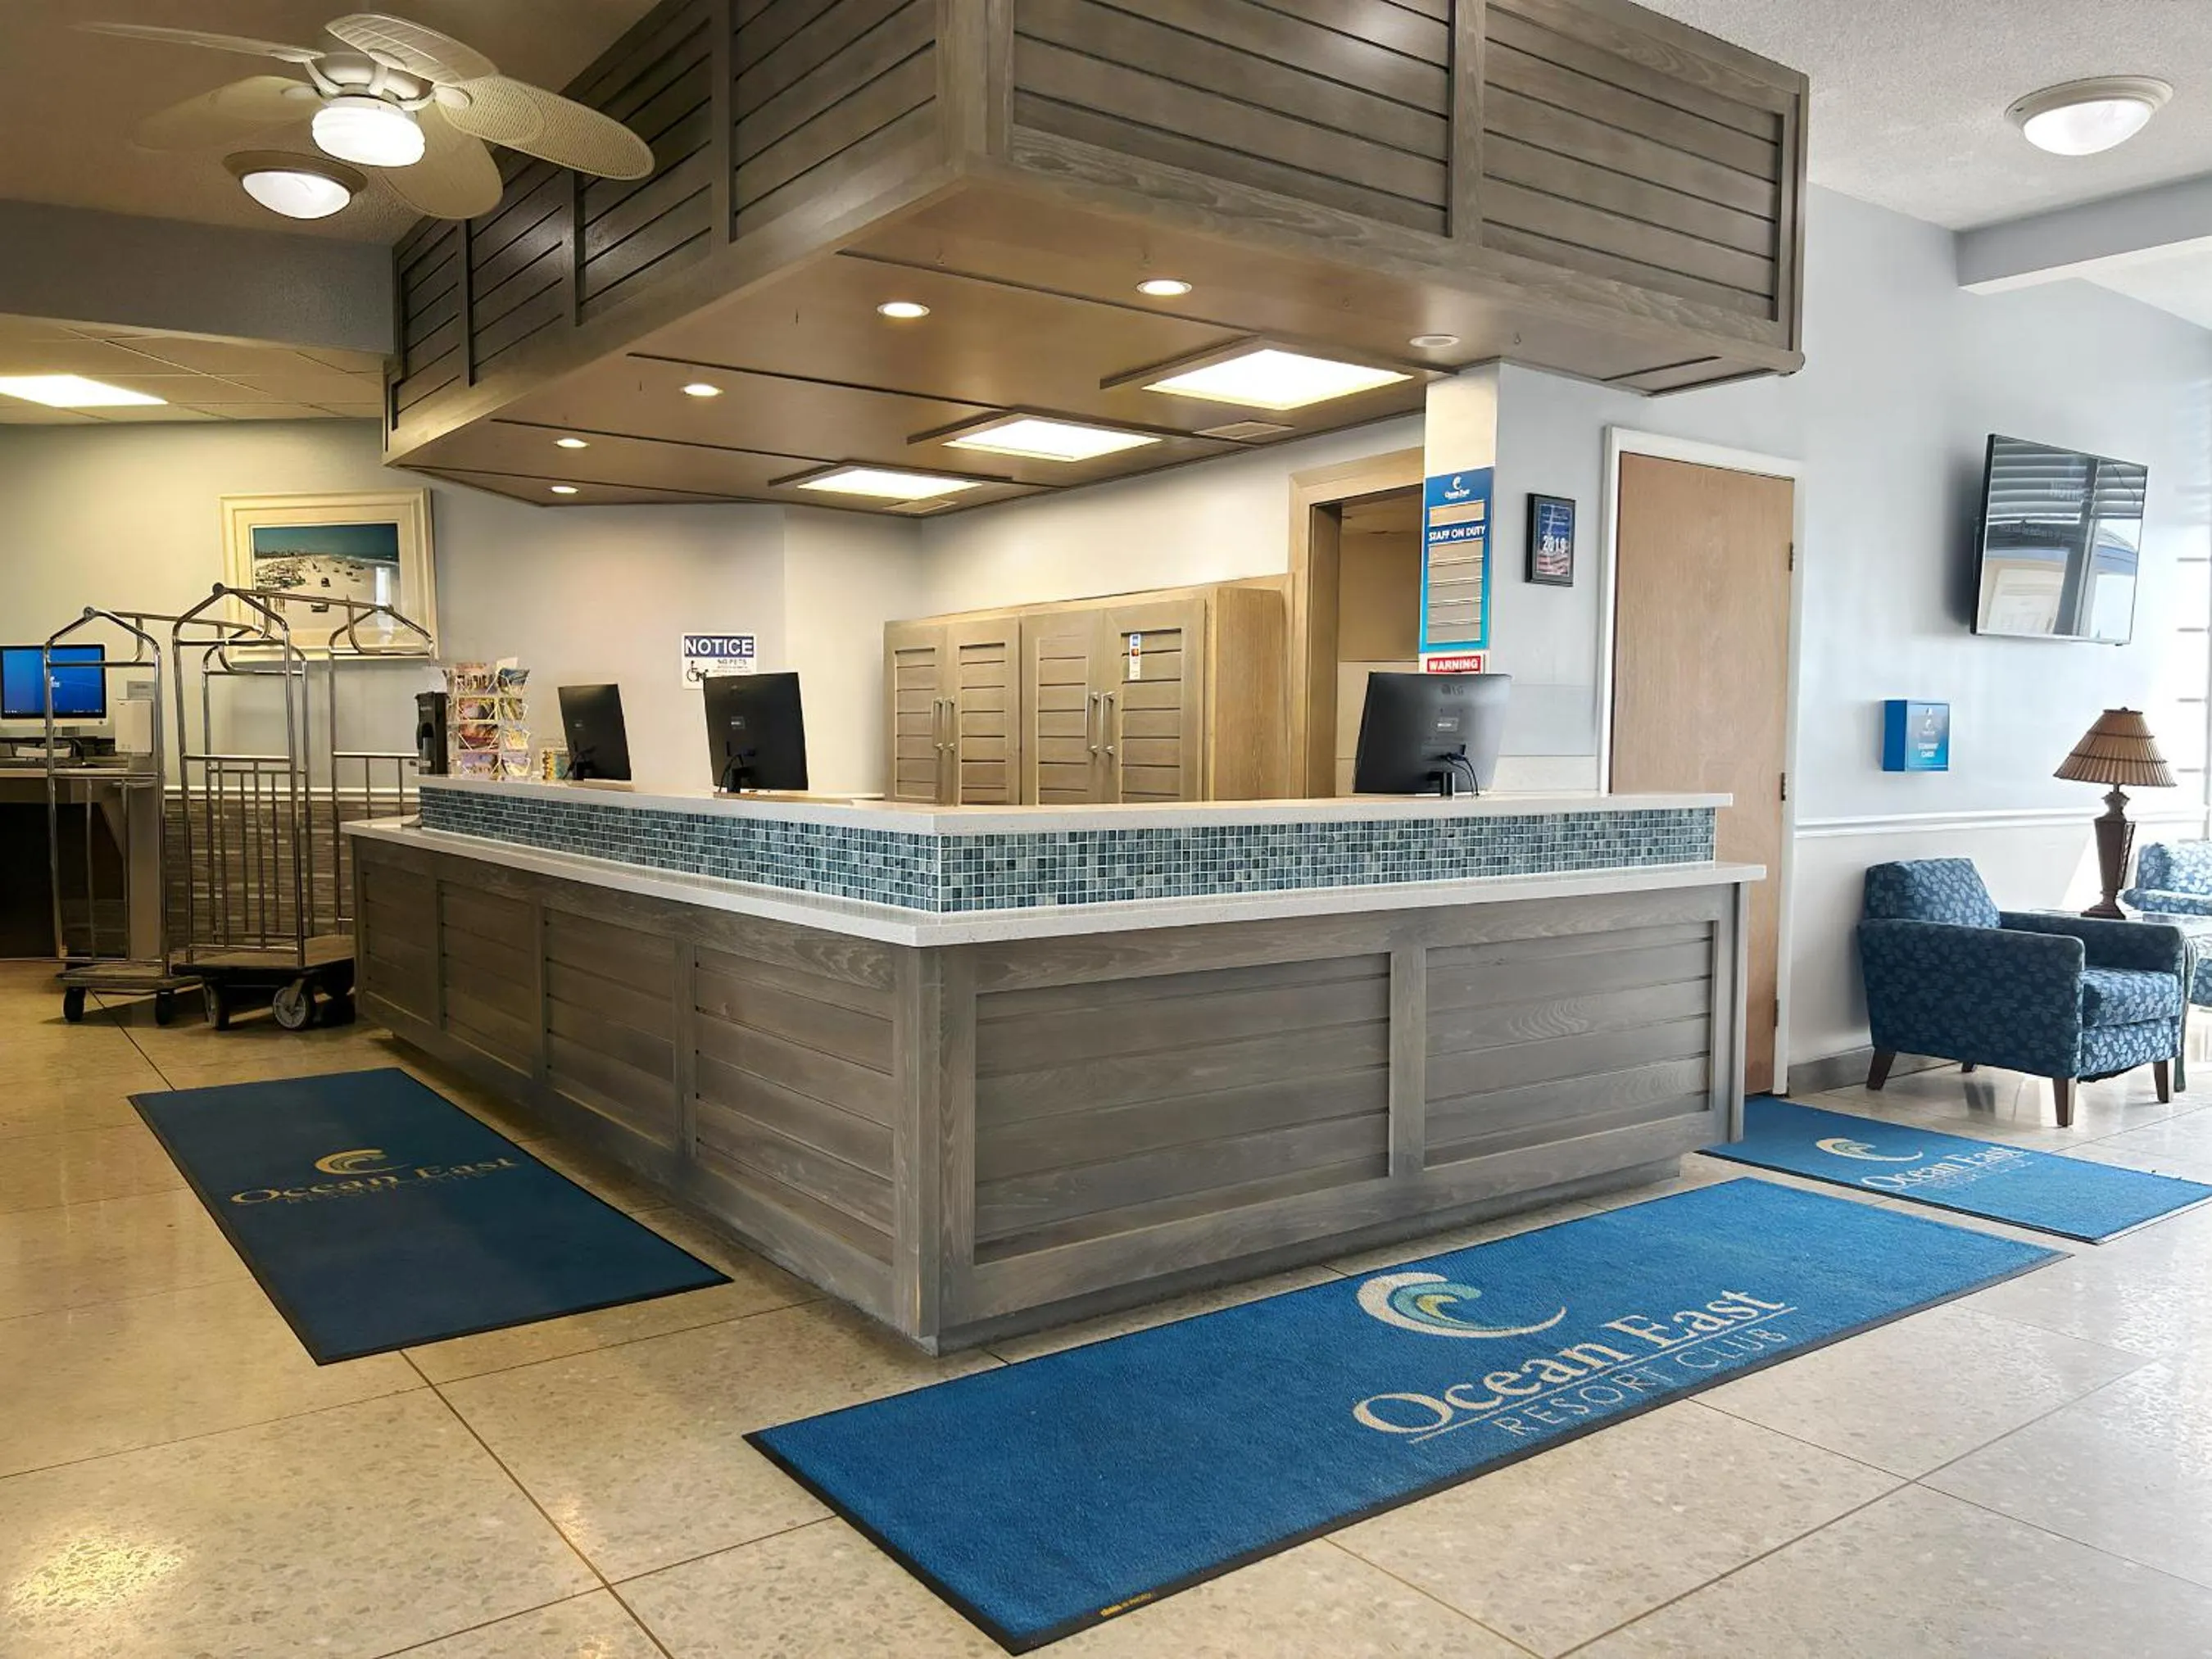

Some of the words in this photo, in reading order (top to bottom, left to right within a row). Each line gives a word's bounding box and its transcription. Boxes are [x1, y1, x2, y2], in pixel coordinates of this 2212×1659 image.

[1429, 530, 1449, 541] STAFF
[1451, 528, 1464, 538] ON
[1466, 525, 1485, 537] DUTY
[685, 638, 753, 655] NOTICE
[1429, 658, 1479, 670] WARNING
[229, 1176, 400, 1205] Ocean
[414, 1158, 519, 1179] East
[1353, 1341, 1636, 1433] Ocean
[1602, 1289, 1786, 1349] East
[1492, 1366, 1673, 1435] RESORT
[1675, 1327, 1788, 1369] CLUB
